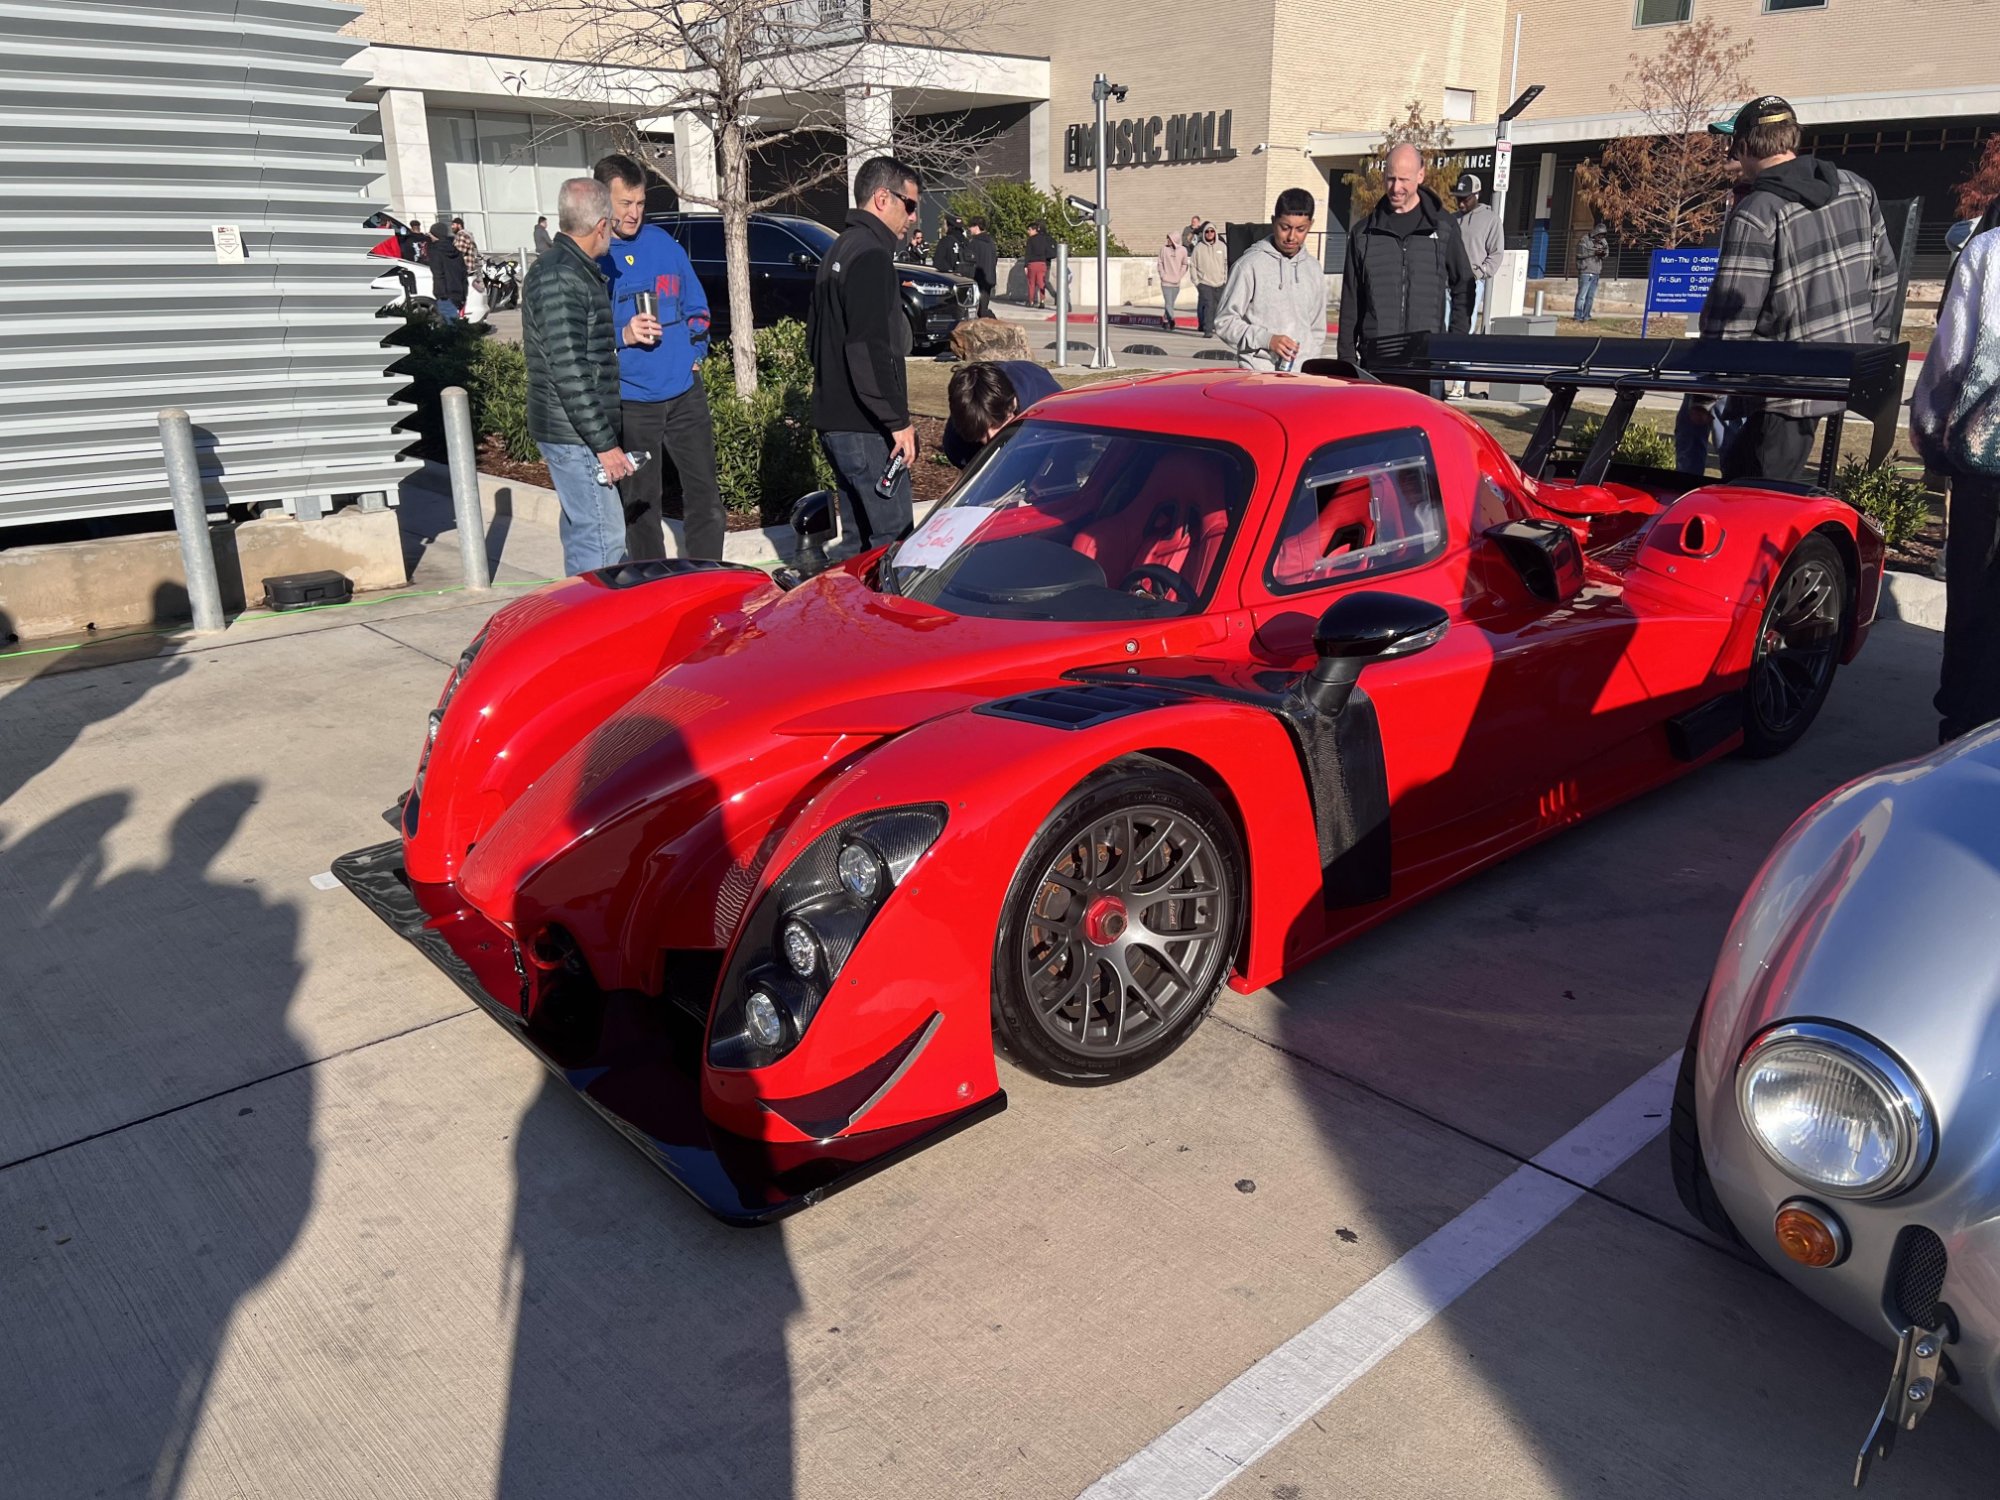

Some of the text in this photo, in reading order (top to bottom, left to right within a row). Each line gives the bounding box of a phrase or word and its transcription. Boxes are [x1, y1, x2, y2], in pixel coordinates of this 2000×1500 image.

[1166, 109, 1237, 161] HALL
[1437, 154, 1492, 169] ENANCE
[916, 527, 954, 548] Sale
